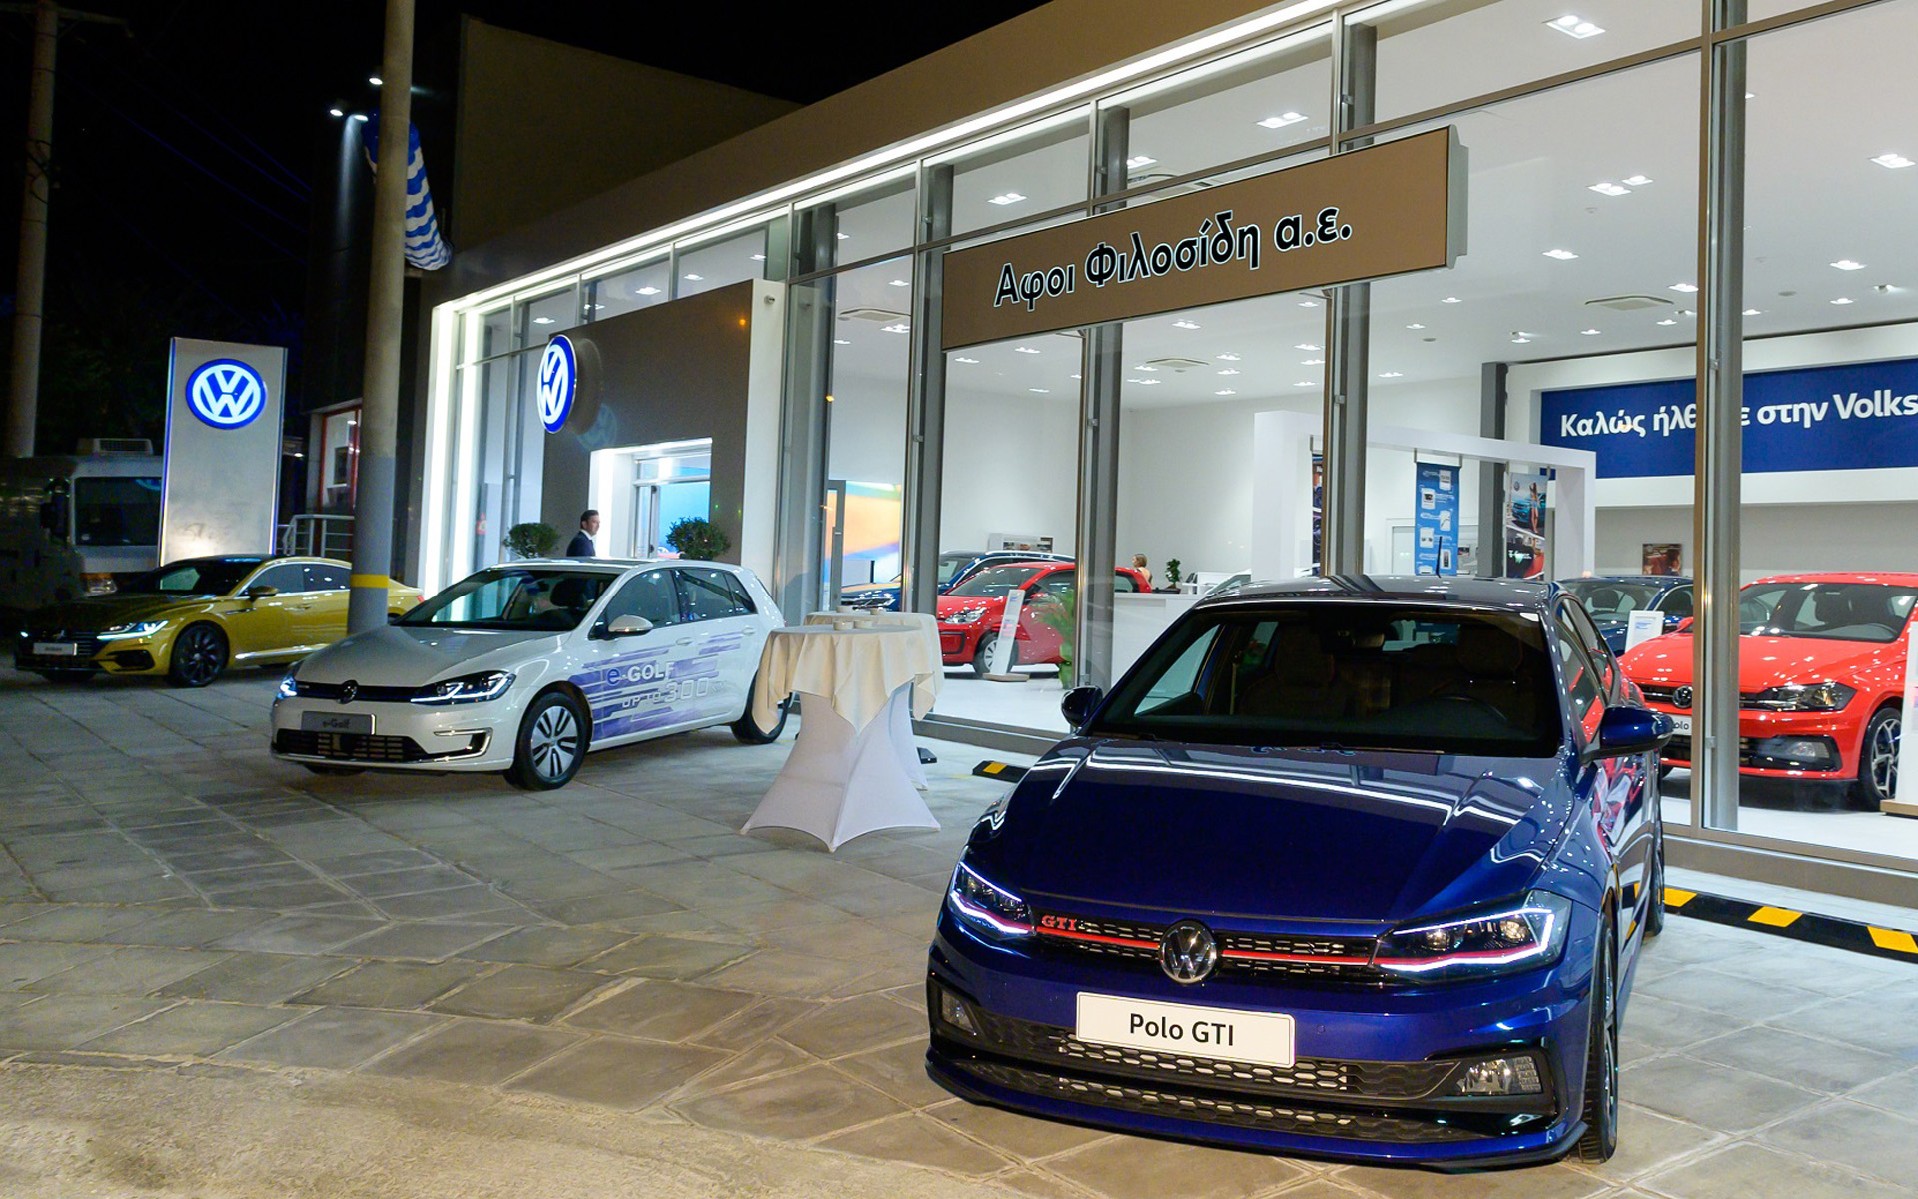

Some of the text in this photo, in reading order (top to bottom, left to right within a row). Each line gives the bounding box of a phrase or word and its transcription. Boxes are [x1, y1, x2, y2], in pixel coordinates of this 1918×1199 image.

[994, 206, 1353, 312] Αφοι Φιλοσίδη α.ε.
[1560, 389, 1918, 438] Καλώς ήλθε στην Volks
[606, 661, 676, 686] e-GOLF
[664, 677, 709, 703] 300
[1673, 721, 1690, 730] olo
[1041, 914, 1078, 931] GTI
[1130, 1012, 1234, 1046] Polo GTI
